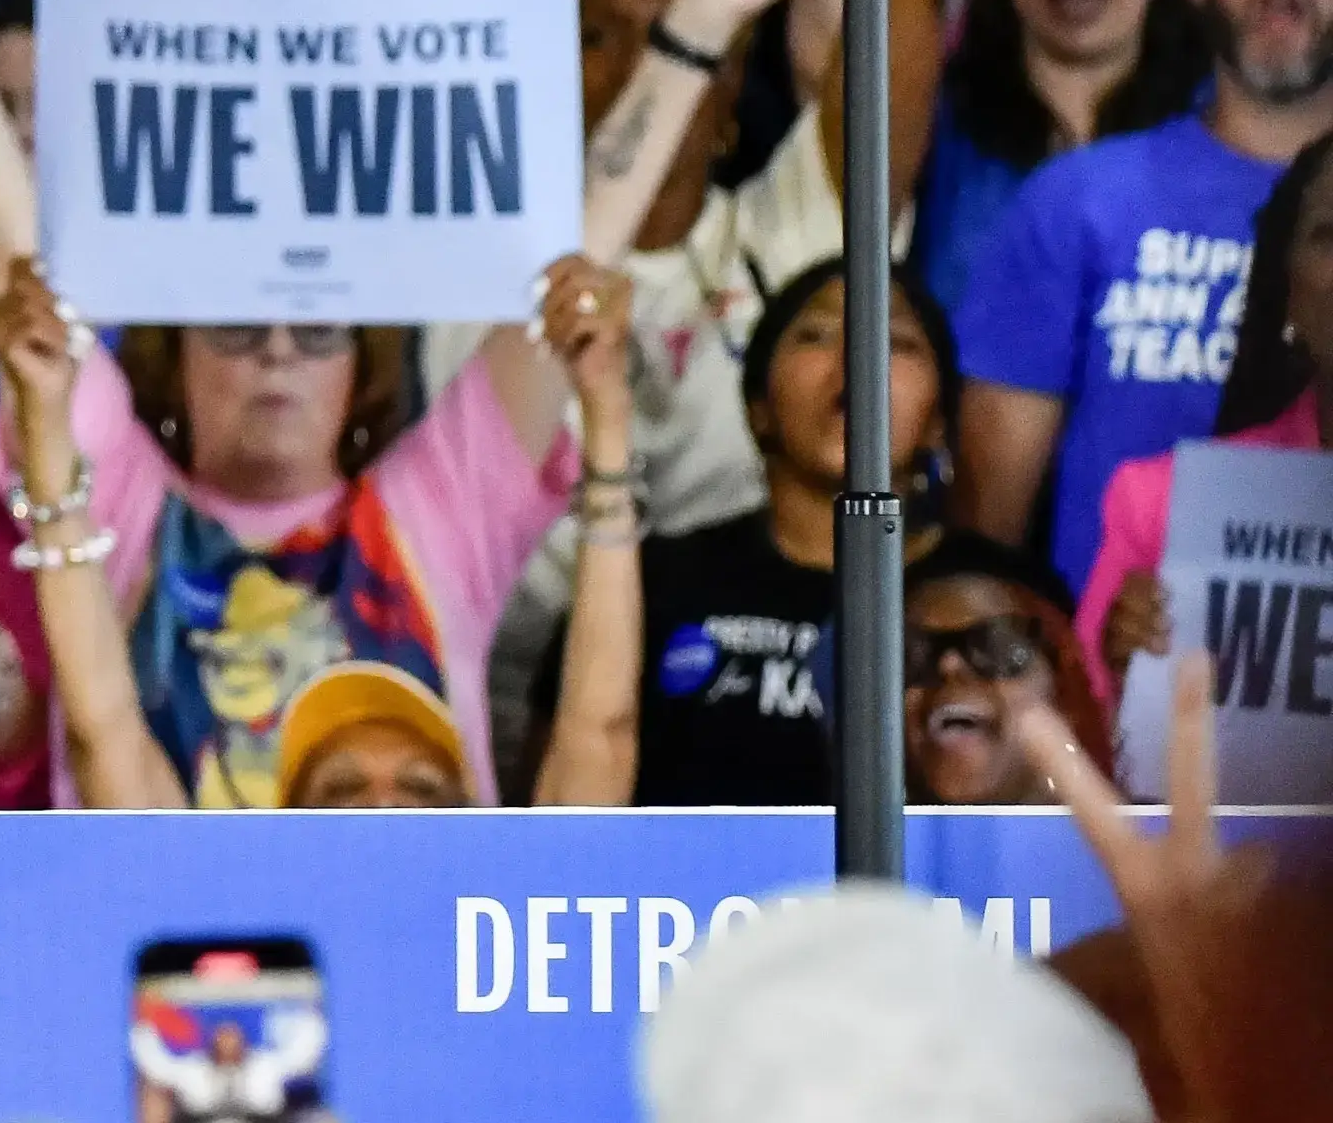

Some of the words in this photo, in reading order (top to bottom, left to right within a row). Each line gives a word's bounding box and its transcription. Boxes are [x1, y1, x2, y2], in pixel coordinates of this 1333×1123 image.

[105, 18, 261, 65] WHEN
[277, 21, 363, 66] WE
[375, 18, 510, 64] VOTE
[92, 77, 262, 218] WE
[288, 77, 525, 219] WIN
[1206, 578, 1333, 717] WE
